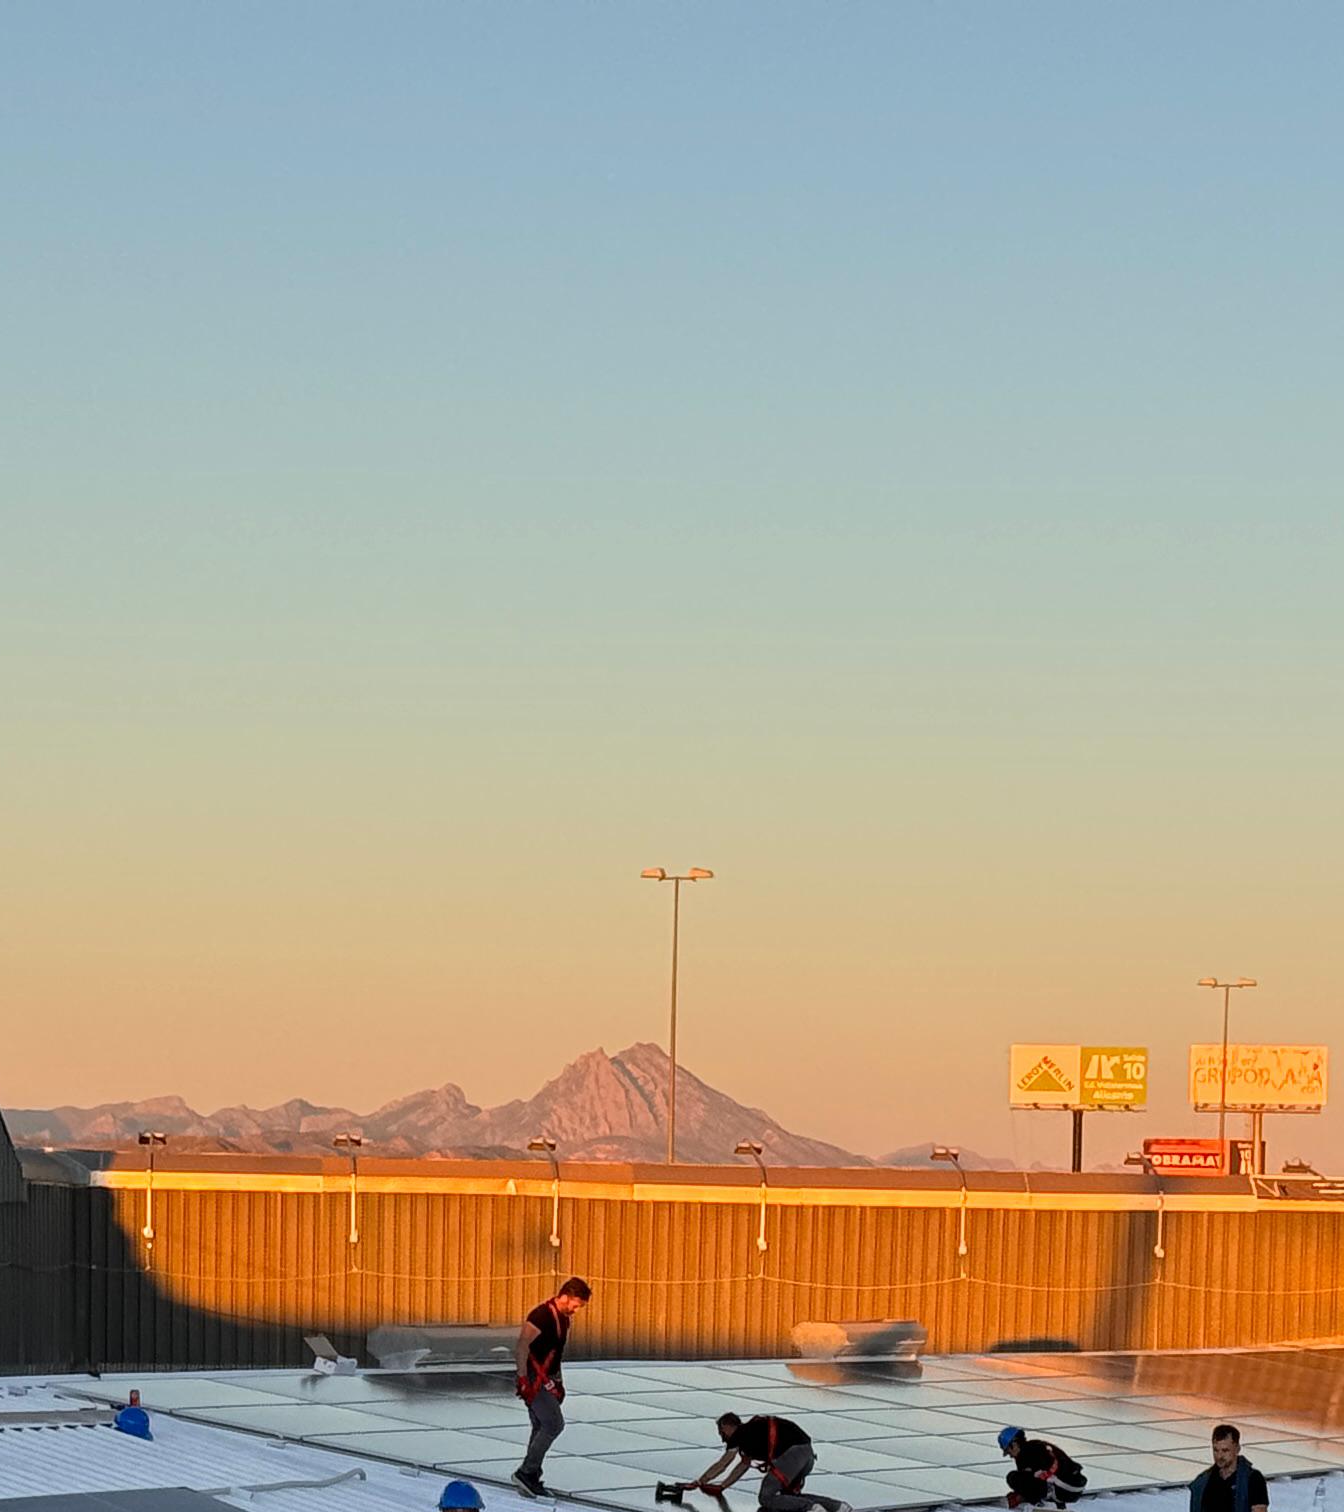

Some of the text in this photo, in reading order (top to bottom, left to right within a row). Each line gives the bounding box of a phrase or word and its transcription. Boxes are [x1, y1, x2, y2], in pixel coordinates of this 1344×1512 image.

[1017, 1056, 1074, 1091] LEROY MERLIN
[1123, 1063, 1144, 1080] 10
